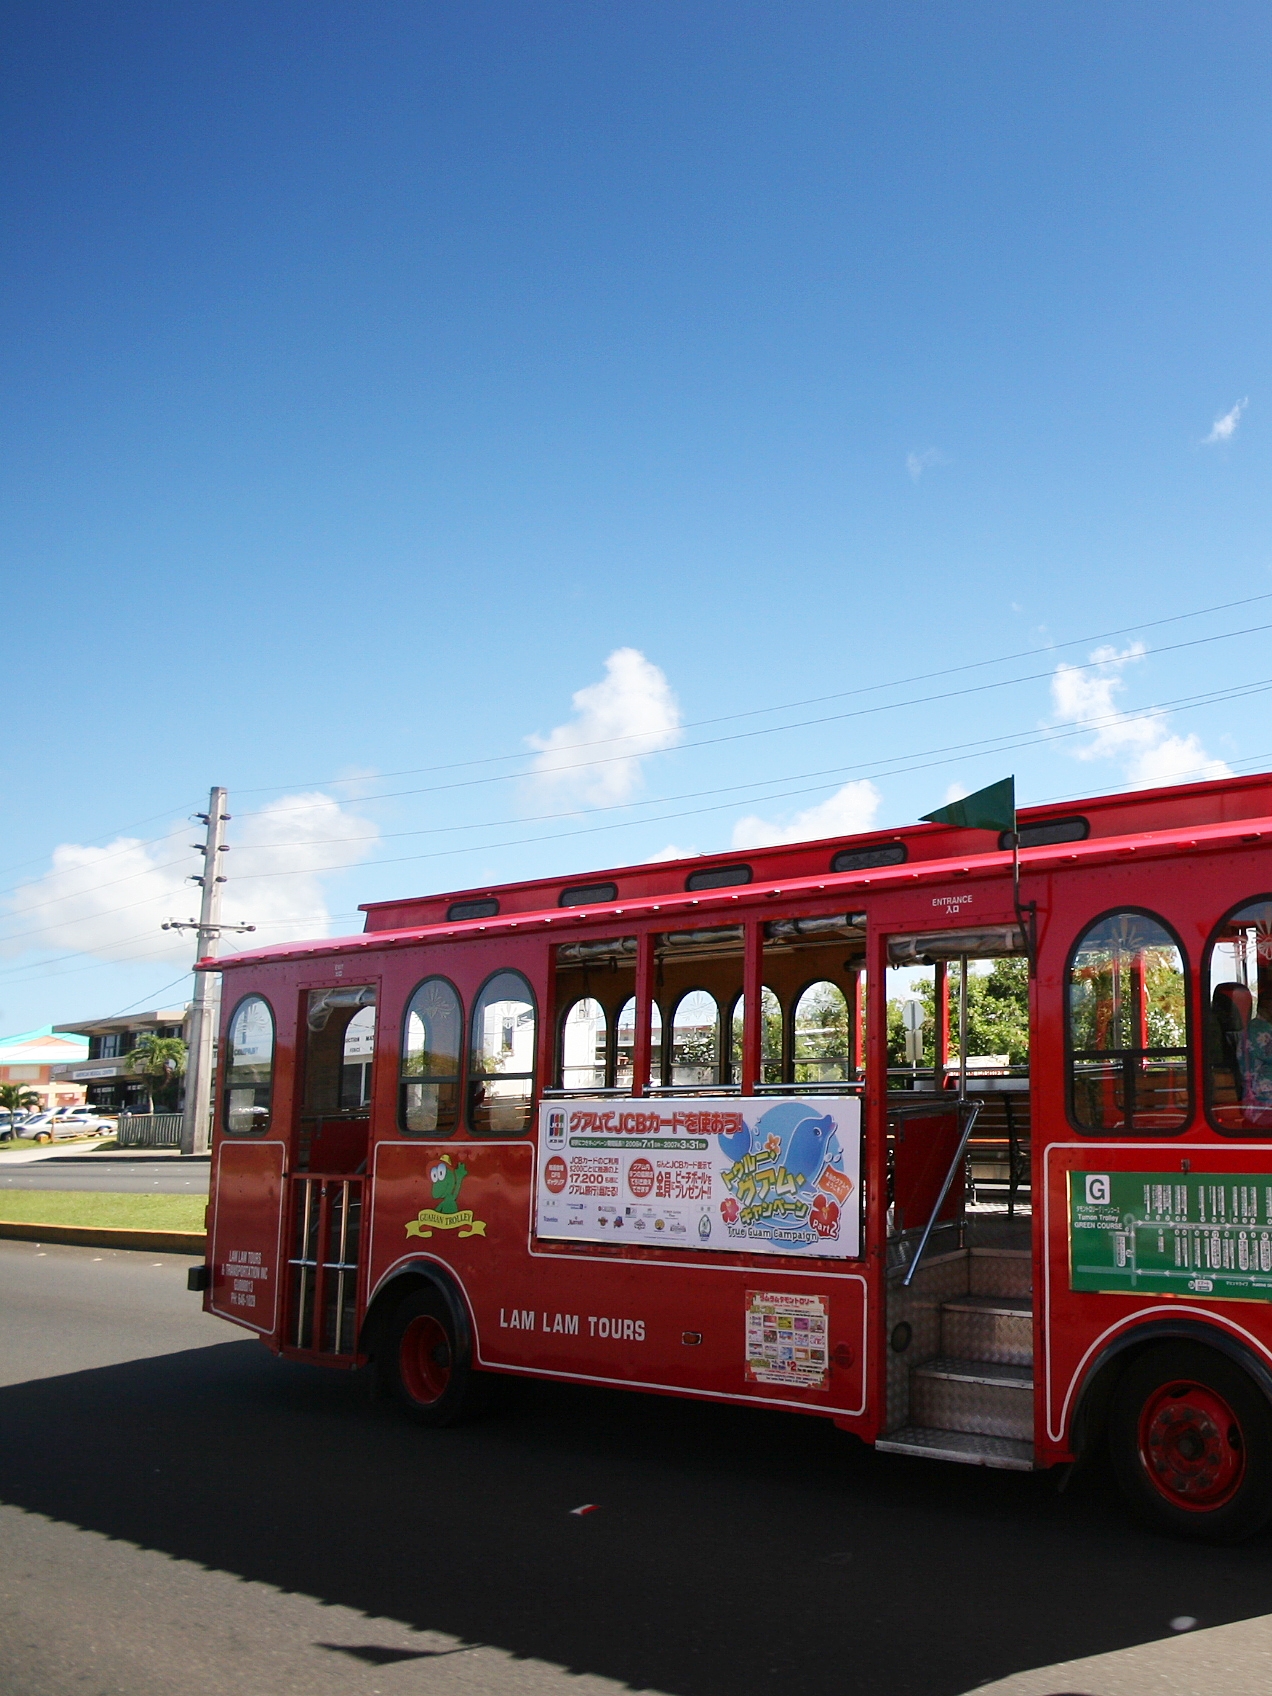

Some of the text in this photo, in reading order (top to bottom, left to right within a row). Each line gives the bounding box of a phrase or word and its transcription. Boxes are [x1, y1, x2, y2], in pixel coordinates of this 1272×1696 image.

[932, 895, 973, 906] ENTRANCE
[946, 905, 960, 914] 入口
[1089, 1178, 1106, 1200] G
[445, 1212, 471, 1226] TROLLEY
[740, 1199, 809, 1226] キャンペーン
[1099, 1214, 1119, 1223] Trolley
[1074, 1221, 1123, 1230] GREEN COURSE
[728, 1226, 817, 1241] True Guam Campaign
[500, 1308, 646, 1341] LAM LAM TOURS
